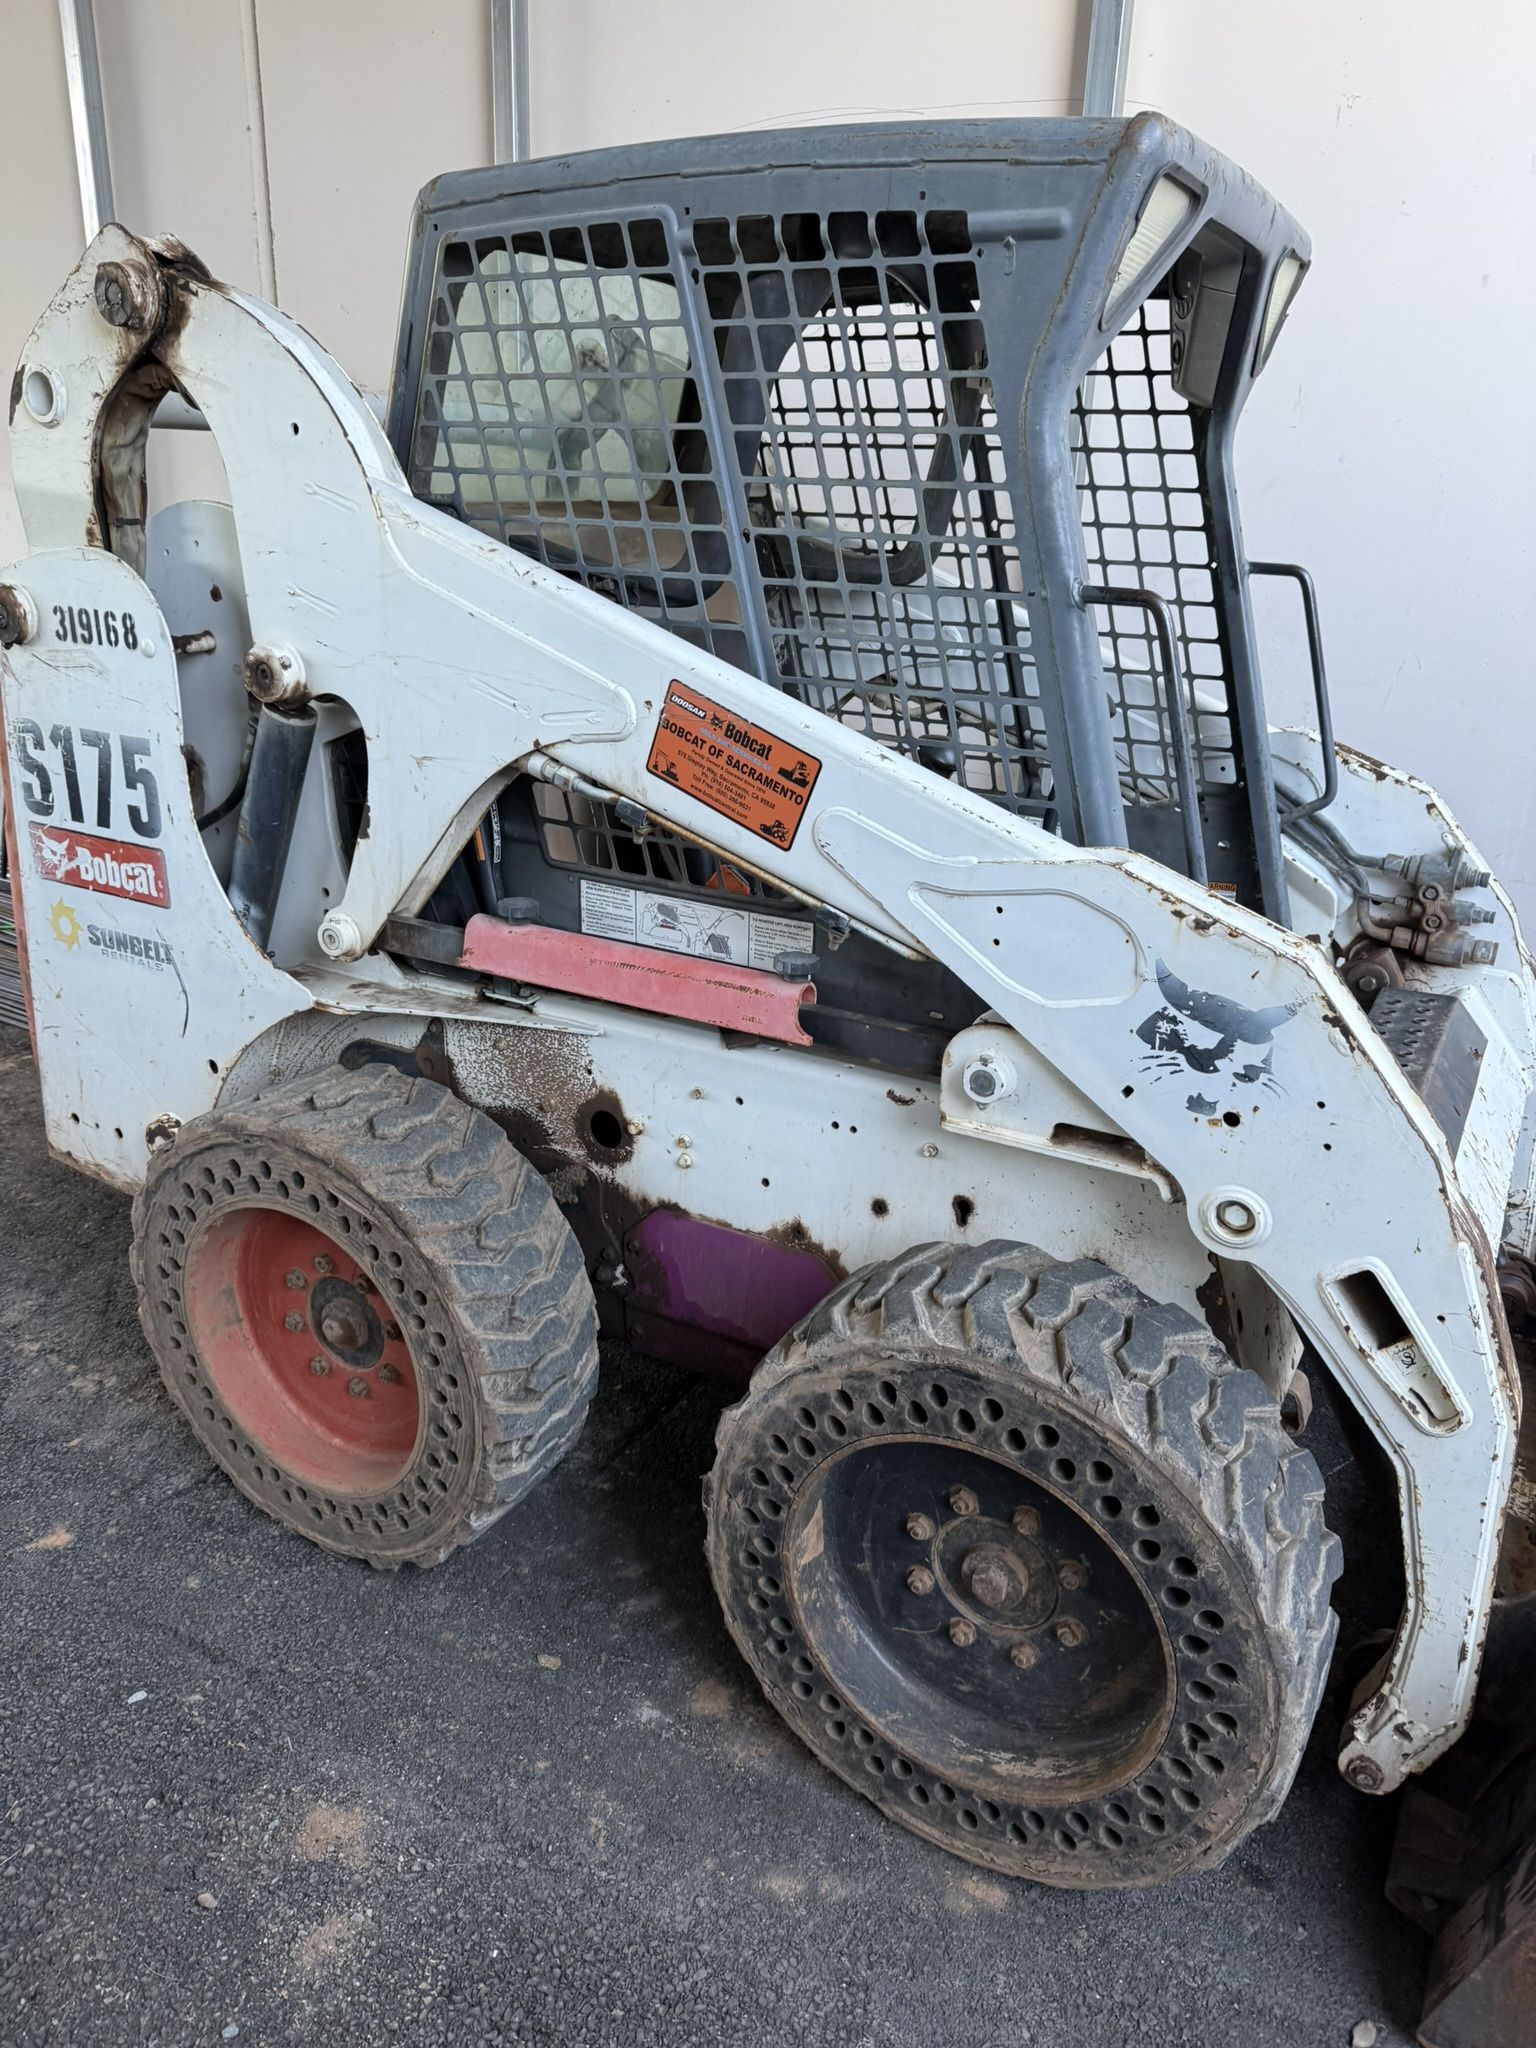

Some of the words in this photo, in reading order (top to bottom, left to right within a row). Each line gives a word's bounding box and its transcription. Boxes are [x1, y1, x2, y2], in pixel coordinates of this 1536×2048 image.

[53, 605, 138, 650] 319168
[670, 694, 706, 718] DOOSAN
[723, 721, 773, 760] Bobcat
[9, 718, 162, 839] S175
[661, 717, 706, 750] BOBCAT
[707, 744, 723, 760] OF
[725, 754, 804, 806] SACRAMENTO
[686, 754, 706, 770] Display
[750, 792, 759, 801] CA
[691, 748, 705, 760] Family
[705, 756, 720, 768] Owned
[724, 767, 743, 782] Operated
[743, 778, 756, 789] Since
[691, 773, 701, 783] Toll
[75, 846, 158, 897] Bobcat
[87, 924, 173, 965] SUNBELT
[101, 949, 164, 972] RENTALS
